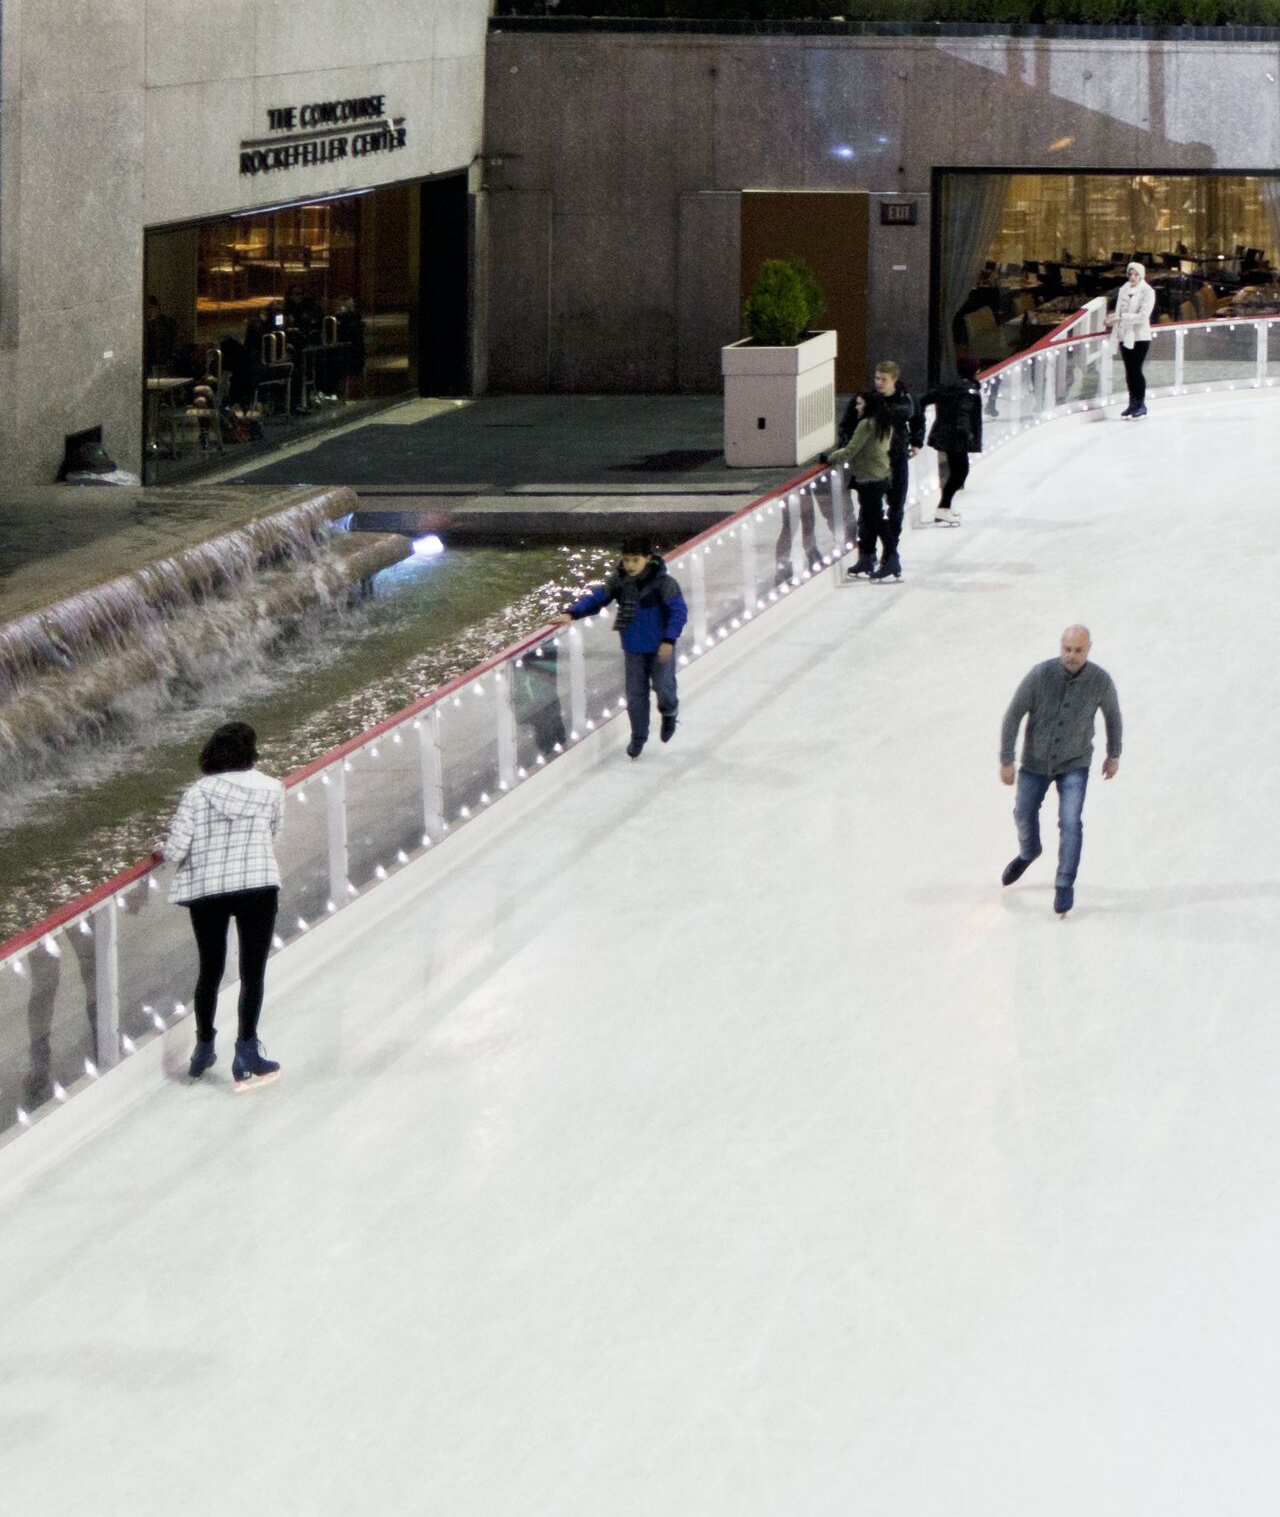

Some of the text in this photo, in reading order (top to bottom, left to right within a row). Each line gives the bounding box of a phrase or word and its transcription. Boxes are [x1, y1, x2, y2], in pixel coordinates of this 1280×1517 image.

[267, 95, 386, 131] THE CONCOURSE
[239, 127, 406, 175] ROCKEFELLER CENTER
